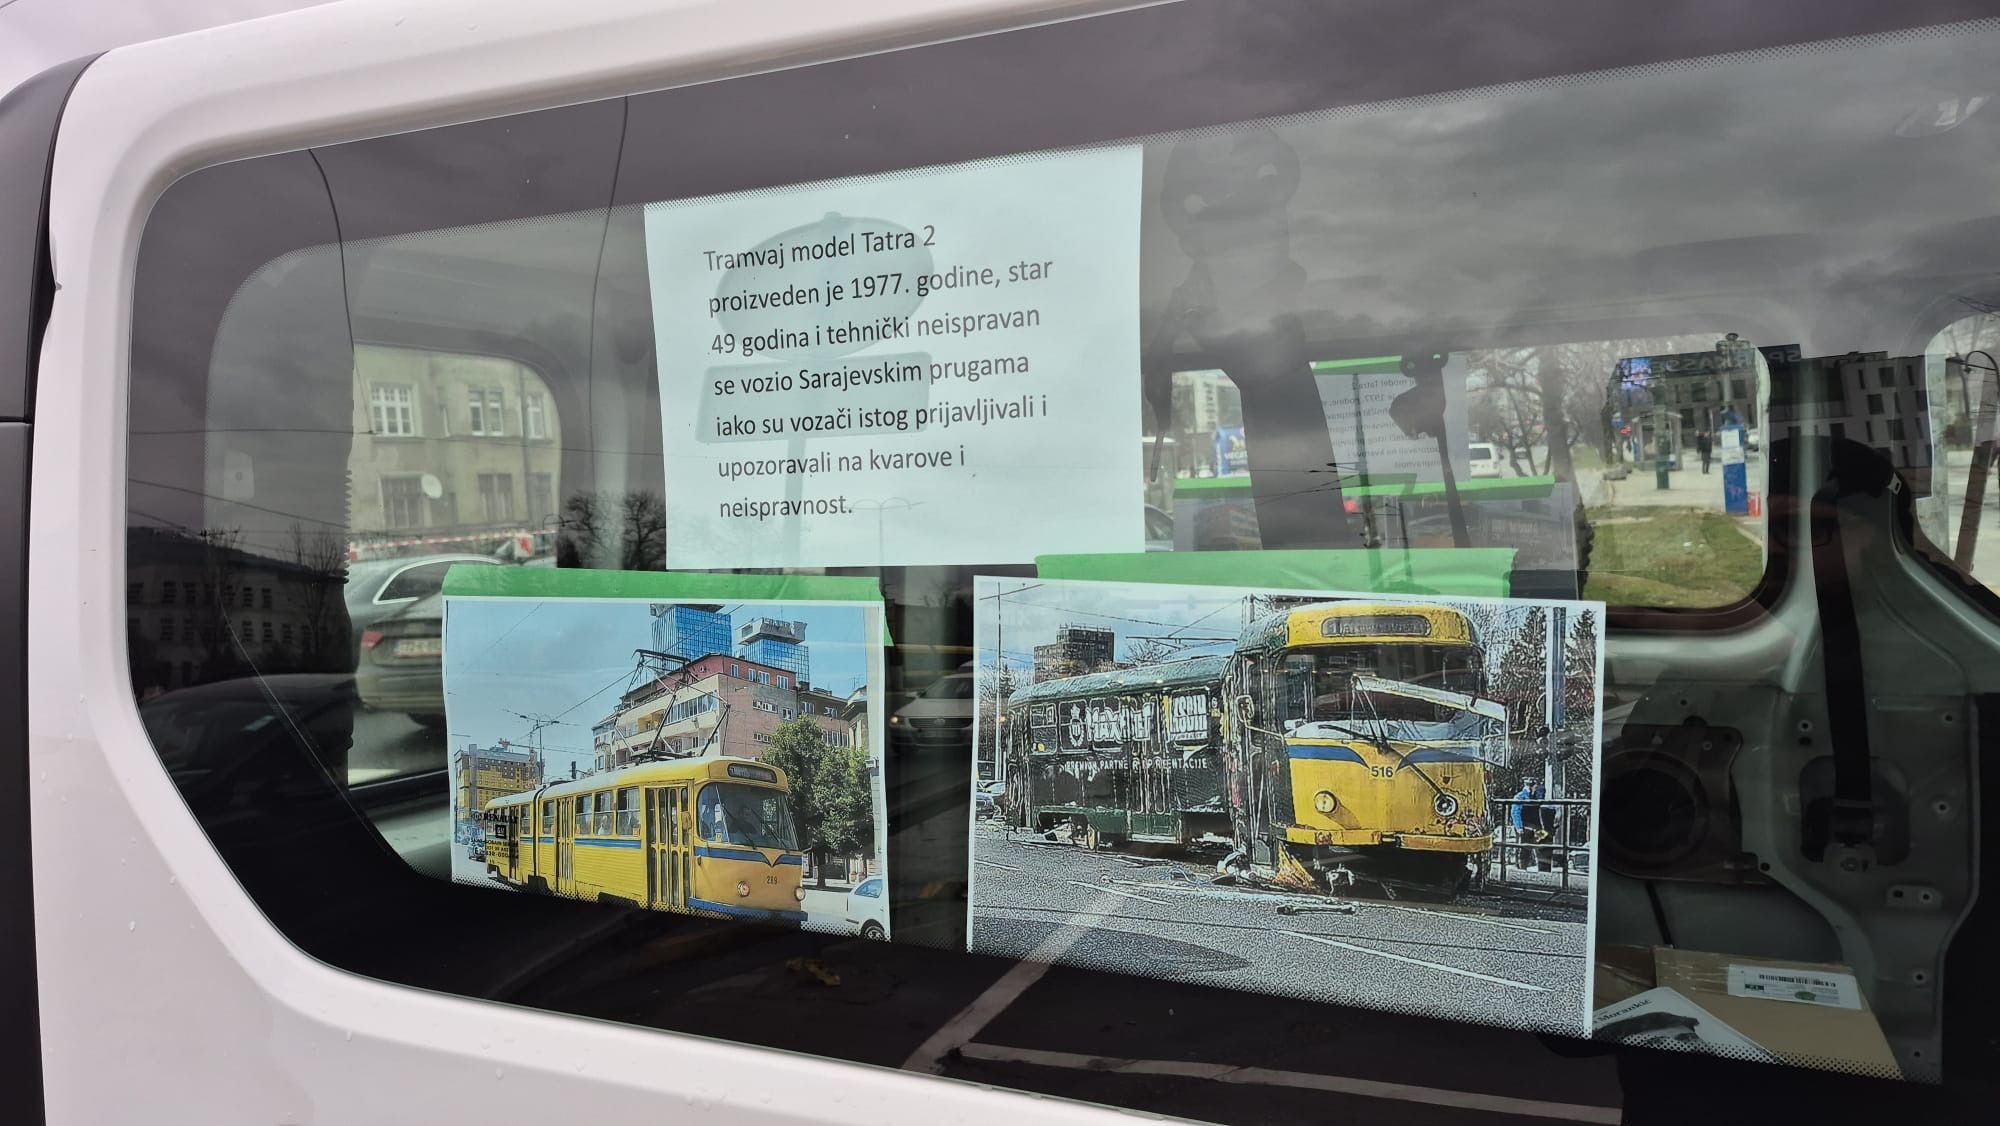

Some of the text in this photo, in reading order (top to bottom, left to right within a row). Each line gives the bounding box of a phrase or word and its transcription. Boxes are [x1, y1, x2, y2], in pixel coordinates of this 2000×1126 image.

[703, 224, 936, 272] Tramvaj model Tatra 2
[708, 260, 1054, 319] proizveden je 1977. godine, star
[711, 308, 1040, 358] 49 godina i tehnički neispravan
[714, 352, 1029, 396] se vozio Sarajevskim prugama
[716, 394, 1047, 437] iako su vozači istog prijavljivali i
[718, 444, 965, 482] upozoravali na kvarove i
[719, 495, 853, 522] neispravnost.
[1371, 765, 1394, 778] 516
